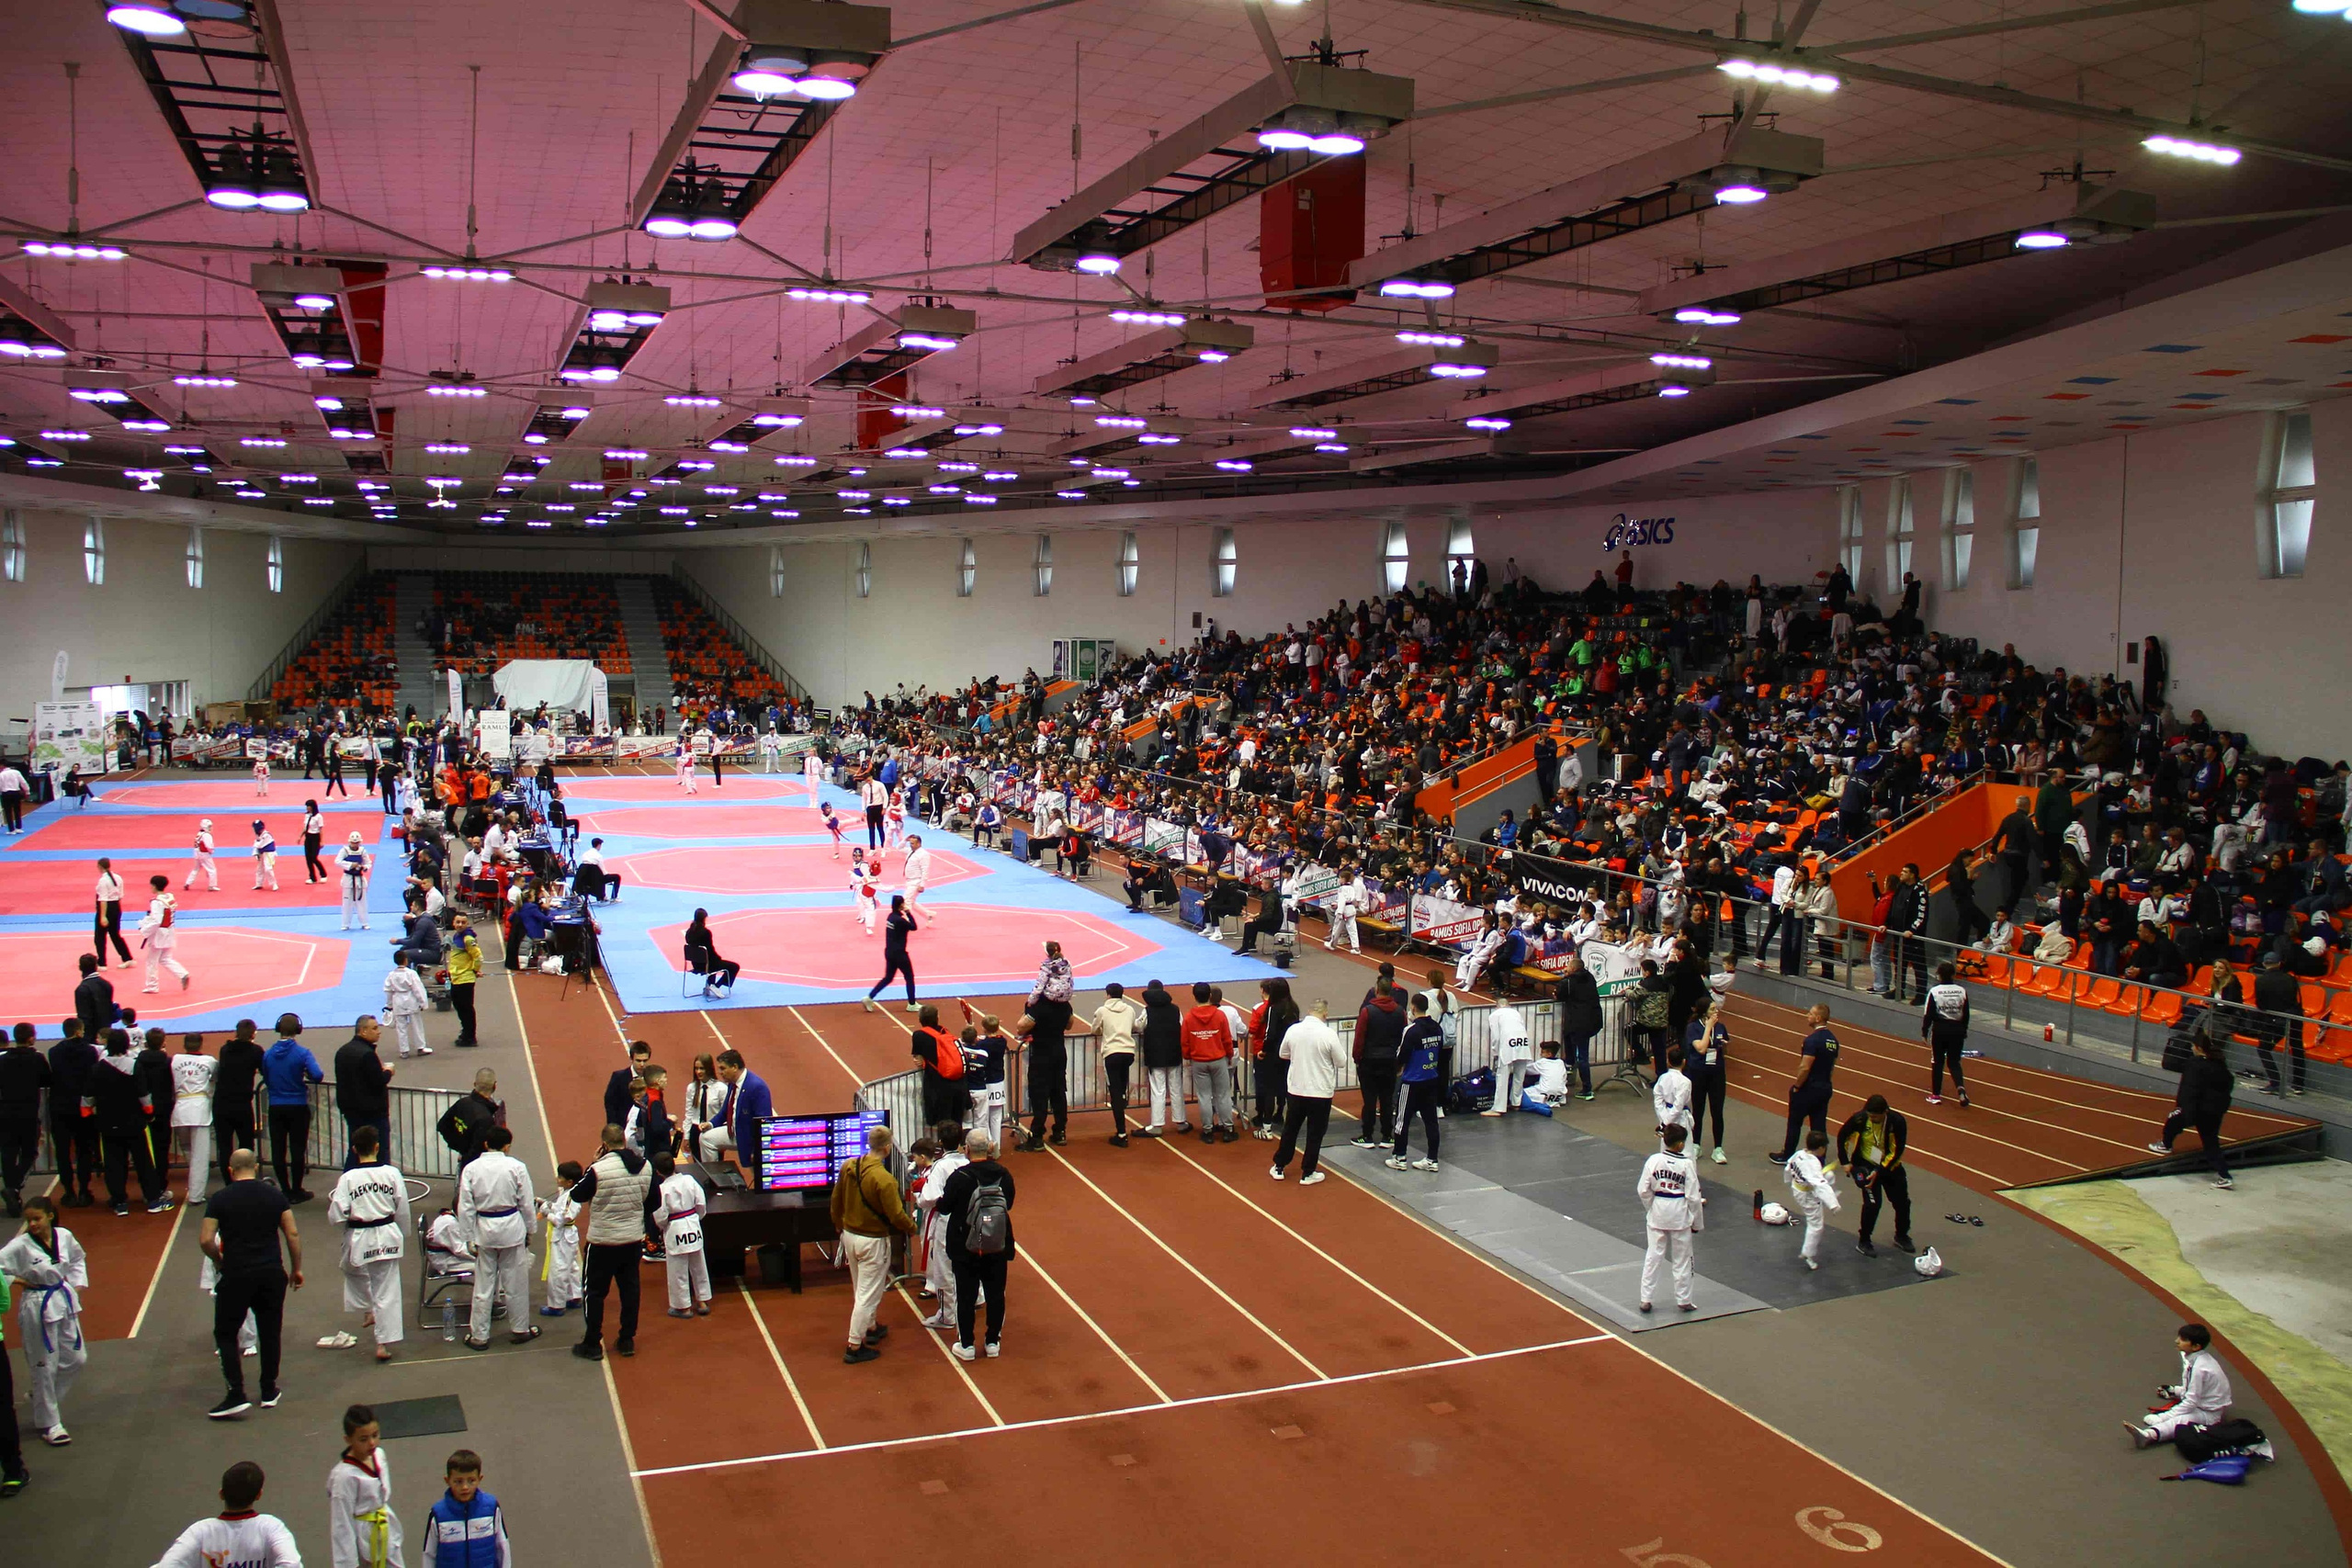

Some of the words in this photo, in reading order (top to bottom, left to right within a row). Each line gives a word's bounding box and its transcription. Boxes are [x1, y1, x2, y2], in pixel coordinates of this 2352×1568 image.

[602, 743, 614, 751] OPEN
[639, 747, 657, 757] RAMUS
[657, 741, 672, 750] SOFIA
[1171, 832, 1184, 842] OPEN
[1269, 867, 1281, 877] OPEN
[1299, 886, 1315, 897] RAMUS
[1315, 882, 1328, 893] SOFIA
[1522, 875, 1589, 903] VIVACOM
[1453, 921, 1472, 935] SOFIA
[1540, 957, 1557, 970] SOFIA
[1623, 966, 1642, 978] MAIN
[1509, 1038, 1529, 1048] GRE
[349, 1182, 395, 1201] TAEKWONDO
[675, 1230, 703, 1247] MDA
[1795, 1506, 1883, 1552] 6
